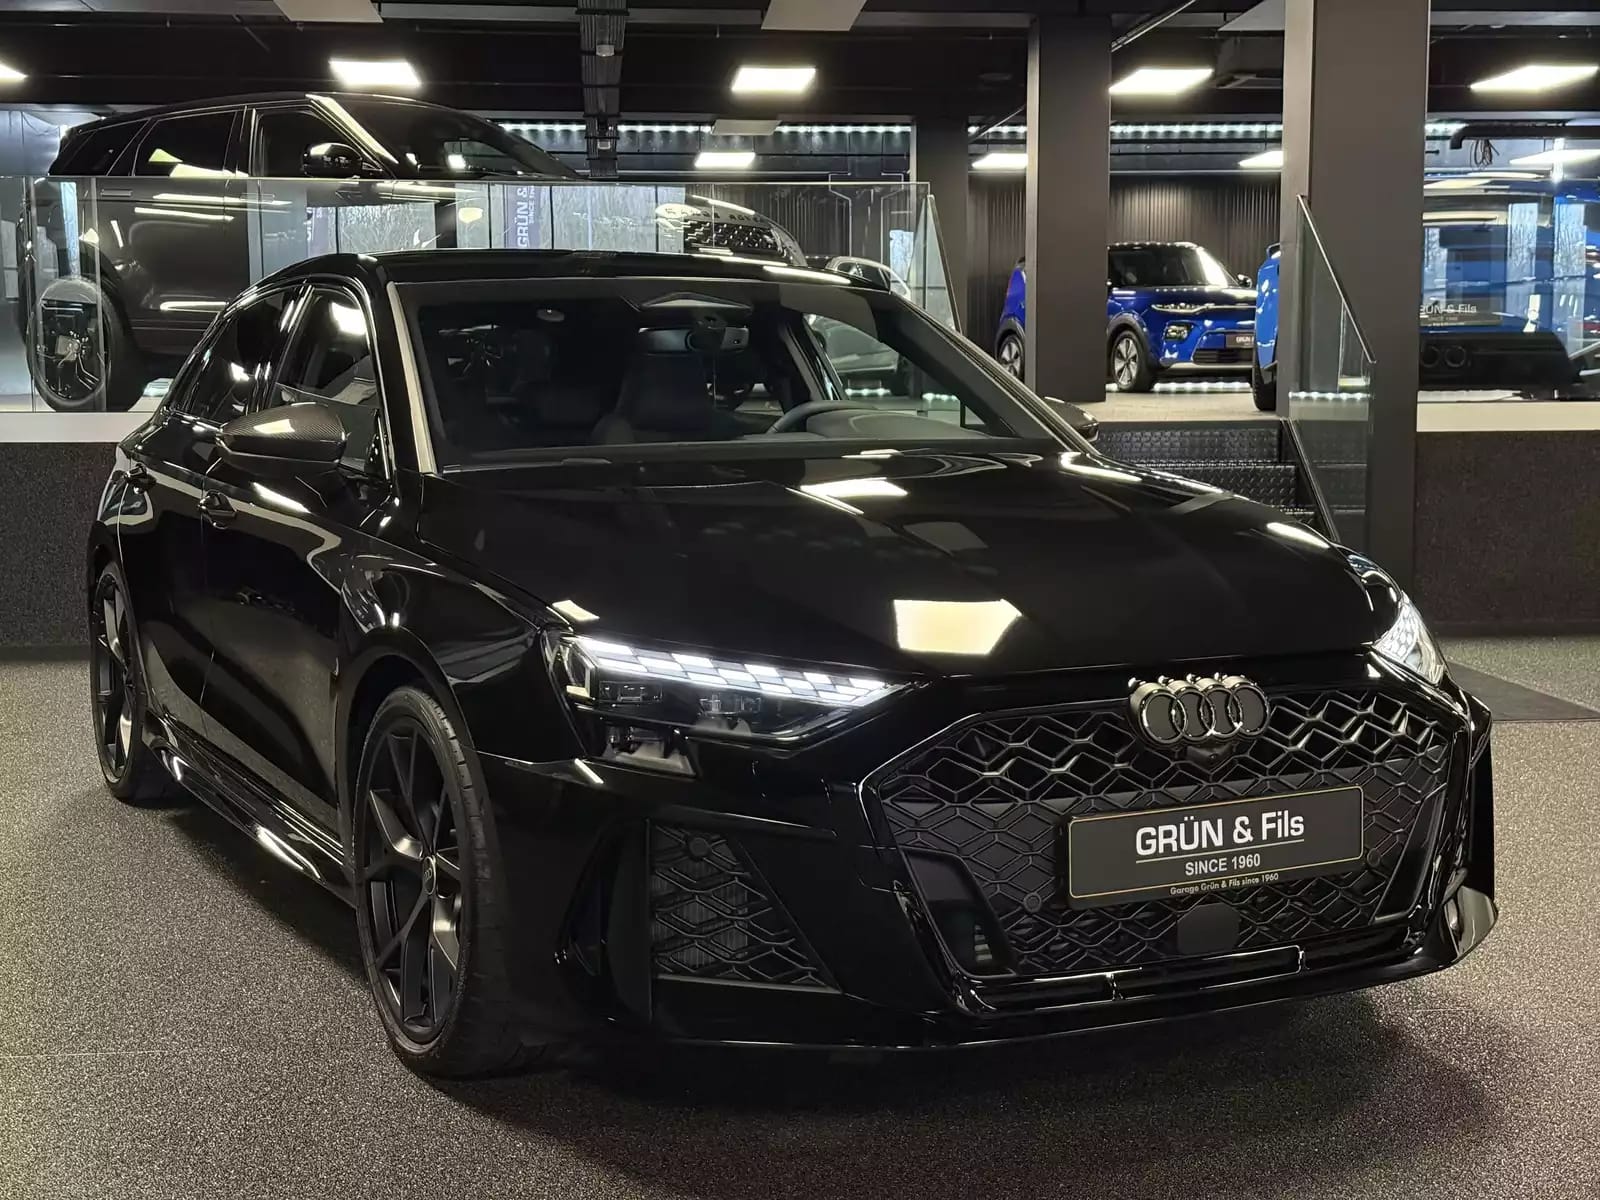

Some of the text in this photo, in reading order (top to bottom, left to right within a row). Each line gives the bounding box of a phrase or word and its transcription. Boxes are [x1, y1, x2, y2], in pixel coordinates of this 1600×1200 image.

[514, 187, 528, 247] GRÜN &
[1136, 809, 1305, 856] GRÜN & Fils
[1185, 853, 1261, 876] SINCE 1960
[1170, 873, 1279, 895] Garage Grün & Fils since 1960
